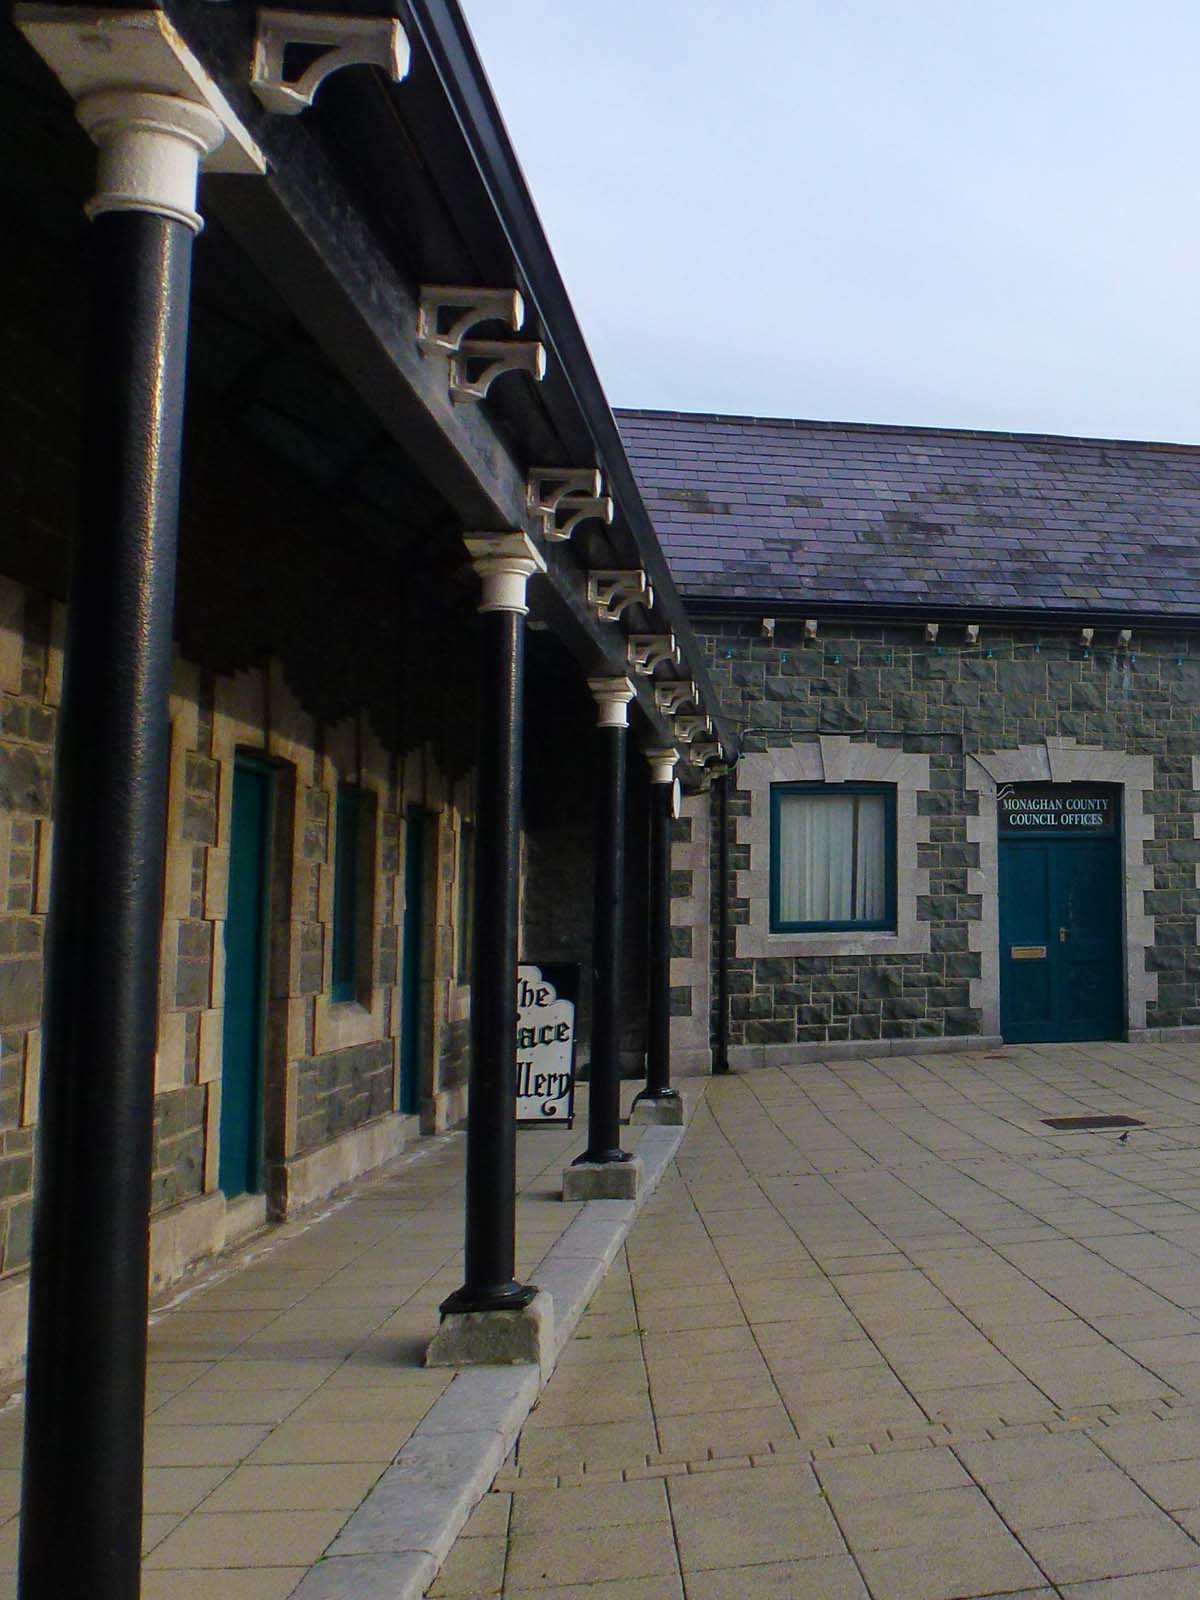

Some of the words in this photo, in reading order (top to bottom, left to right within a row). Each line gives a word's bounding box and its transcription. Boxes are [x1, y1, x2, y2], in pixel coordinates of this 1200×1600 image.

[1003, 799, 1063, 810] MONAGHAN
[1066, 799, 1110, 810] COUNTY
[1009, 813, 1058, 825] COUNCIL
[1060, 813, 1104, 825] OFFICES
[517, 977, 550, 1008] he
[516, 1013, 570, 1050] ace
[516, 1061, 571, 1117] llery
